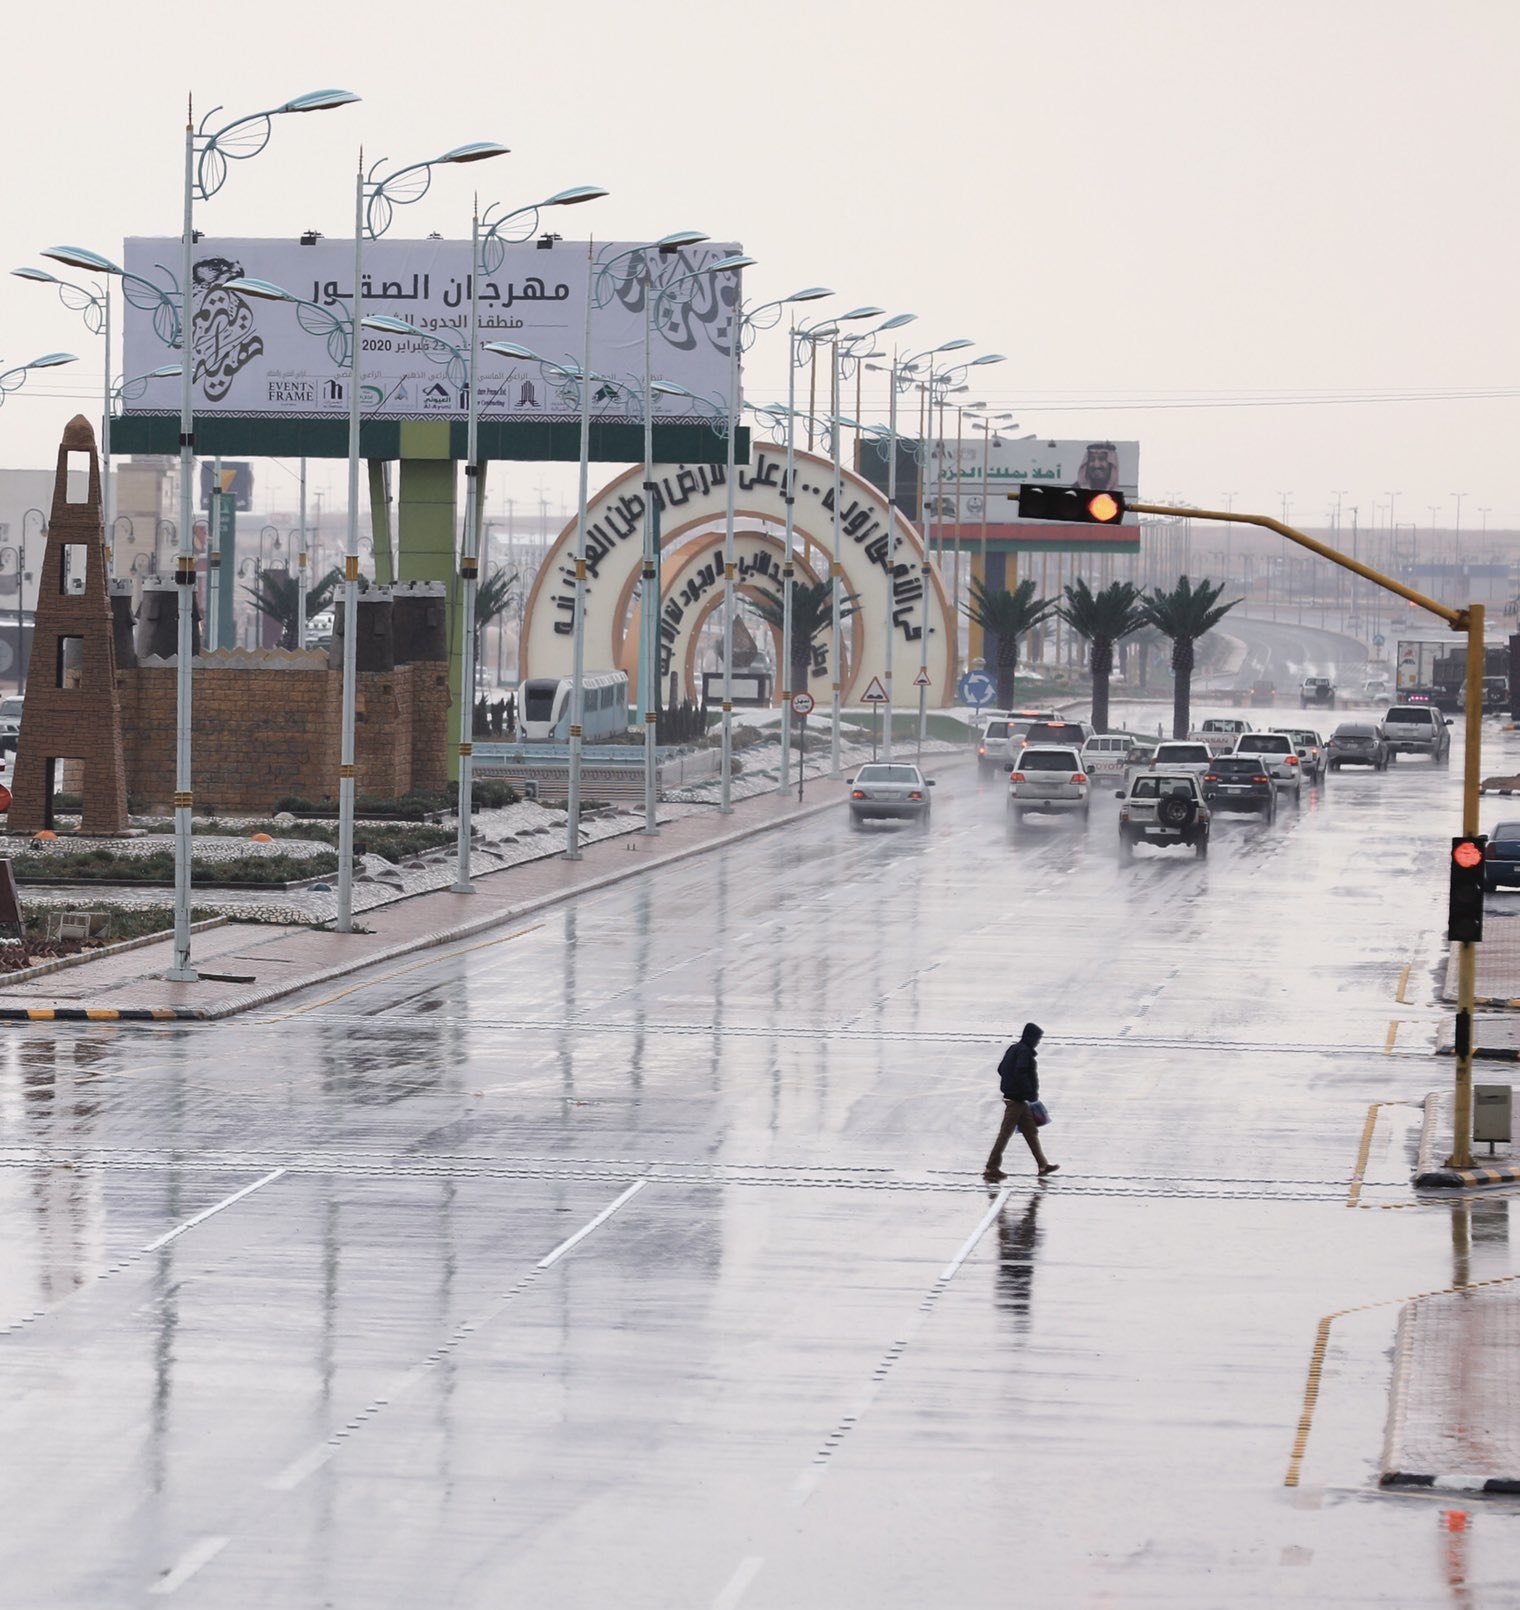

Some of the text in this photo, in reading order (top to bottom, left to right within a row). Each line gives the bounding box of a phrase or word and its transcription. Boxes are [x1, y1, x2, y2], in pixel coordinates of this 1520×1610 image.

[312, 274, 570, 308] مهرجان الصقور
[420, 314, 467, 331] الحدود
[362, 339, 392, 351] 2020
[269, 391, 313, 401] FRAME
[662, 463, 728, 507] لأرض
